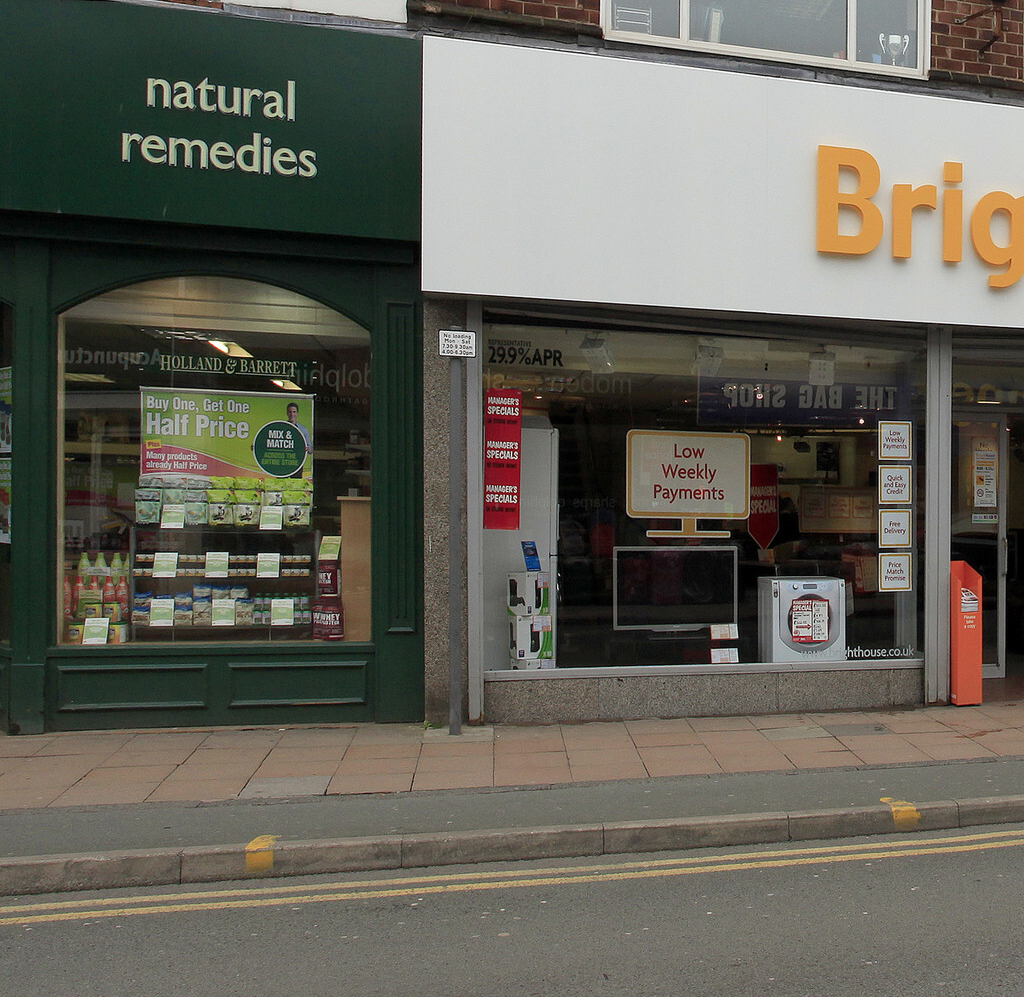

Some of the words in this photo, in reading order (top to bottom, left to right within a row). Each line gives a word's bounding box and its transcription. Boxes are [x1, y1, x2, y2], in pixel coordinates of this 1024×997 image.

[146, 77, 296, 122] natural
[121, 132, 318, 179] remedies
[160, 354, 222, 371] HOLLAND
[225, 357, 238, 375] &
[239, 357, 298, 377] BARRETT
[146, 396, 170, 412] Buy
[172, 397, 199, 413] One,
[203, 399, 224, 413] Get
[227, 400, 250, 414] One
[487, 396, 519, 405] MANAGER'S
[487, 406, 519, 416] SPECIALS
[146, 412, 190, 436] Half
[195, 414, 250, 439] Price
[268, 429, 285, 439] MIX
[286, 430, 293, 440] &
[266, 439, 295, 449] MATCH
[486, 440, 518, 449] MANAGER'S
[883, 443, 908, 451] Payments
[486, 450, 518, 460] SPECIALS
[674, 443, 705, 459] Low
[146, 451, 165, 461] Many
[166, 453, 198, 463] products
[146, 461, 171, 471] already
[173, 462, 189, 471] Half
[190, 463, 208, 471] Price
[661, 463, 717, 484] Weekly
[886, 474, 903, 483] Quick
[485, 484, 517, 493] MANAGER'S
[485, 494, 517, 504] SPECIALS
[653, 484, 725, 504] Payments
[884, 527, 906, 535] Delivery
